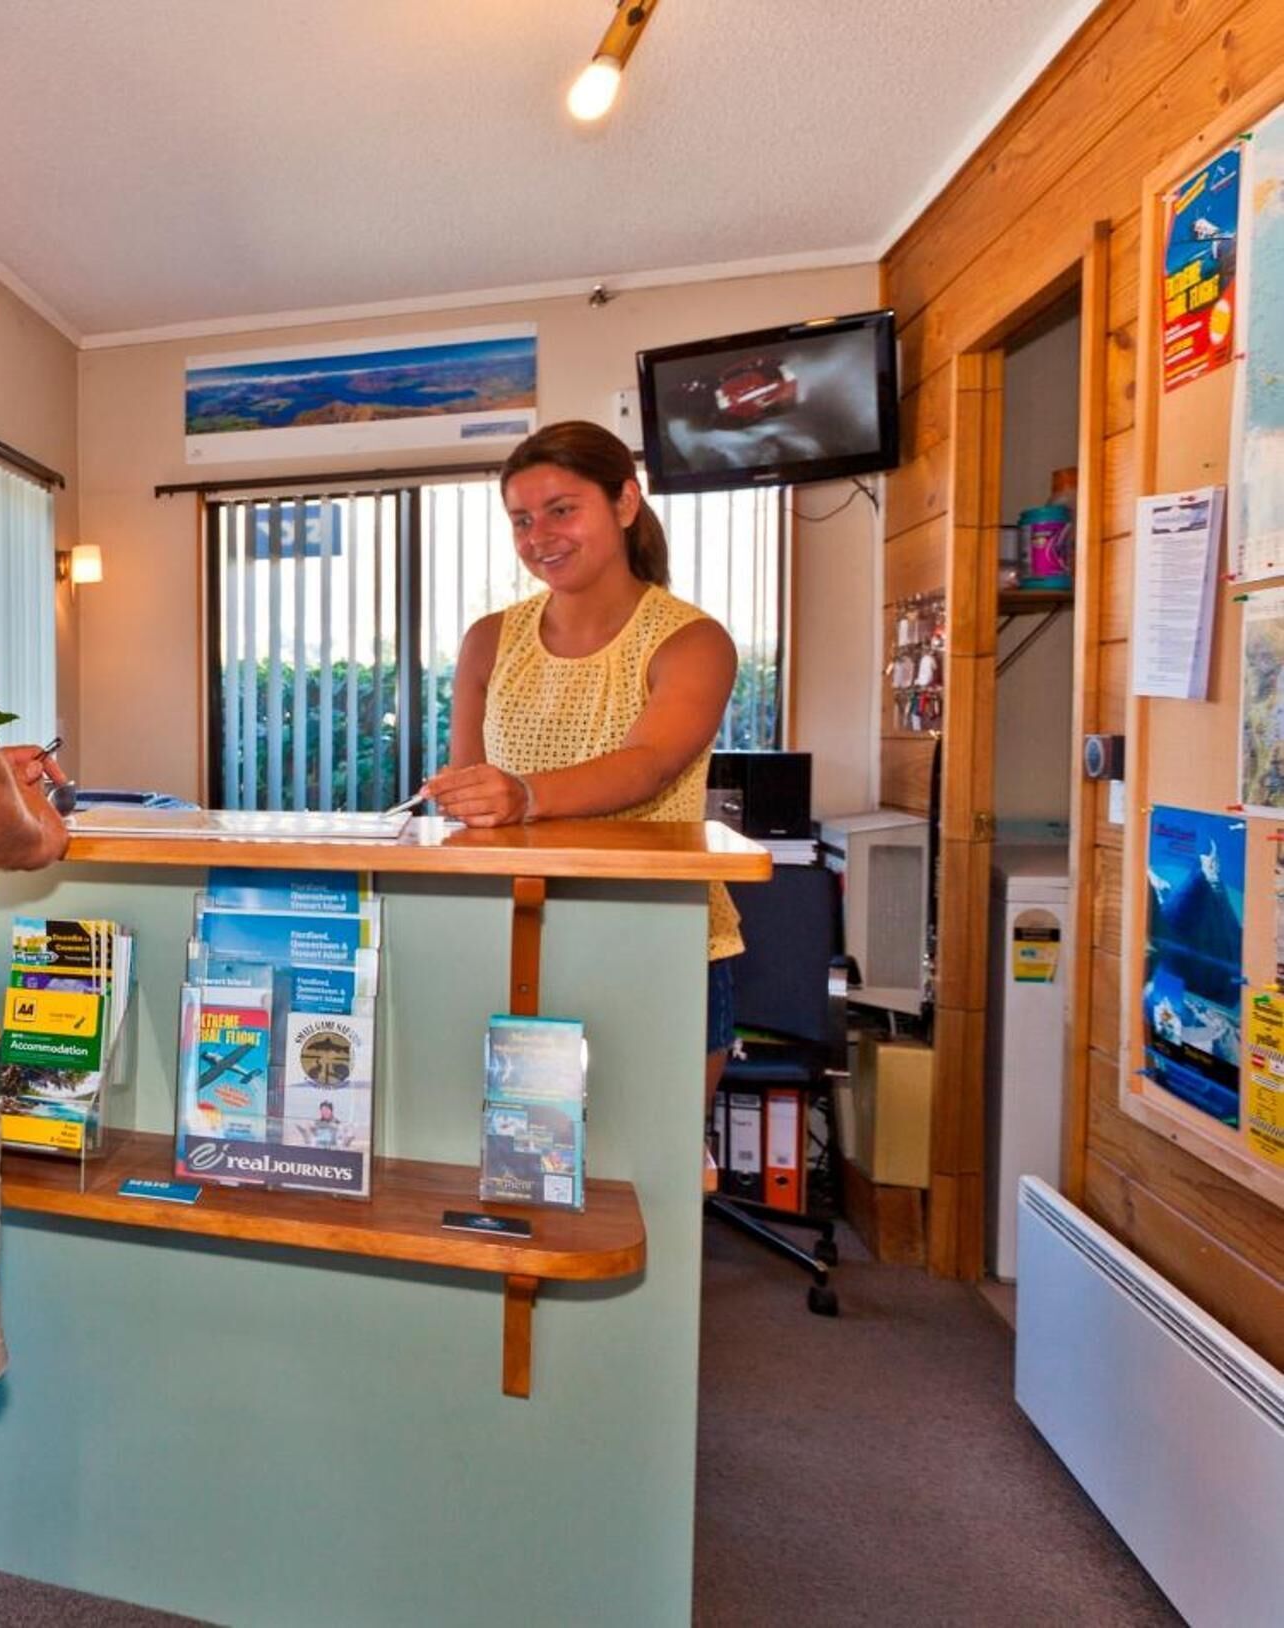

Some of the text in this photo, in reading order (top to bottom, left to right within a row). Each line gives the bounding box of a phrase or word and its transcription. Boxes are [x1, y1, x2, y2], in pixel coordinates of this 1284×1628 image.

[17, 1003, 35, 1016] AA
[225, 1030, 262, 1047] FLIGHT
[10, 1040, 89, 1057] Accommodation
